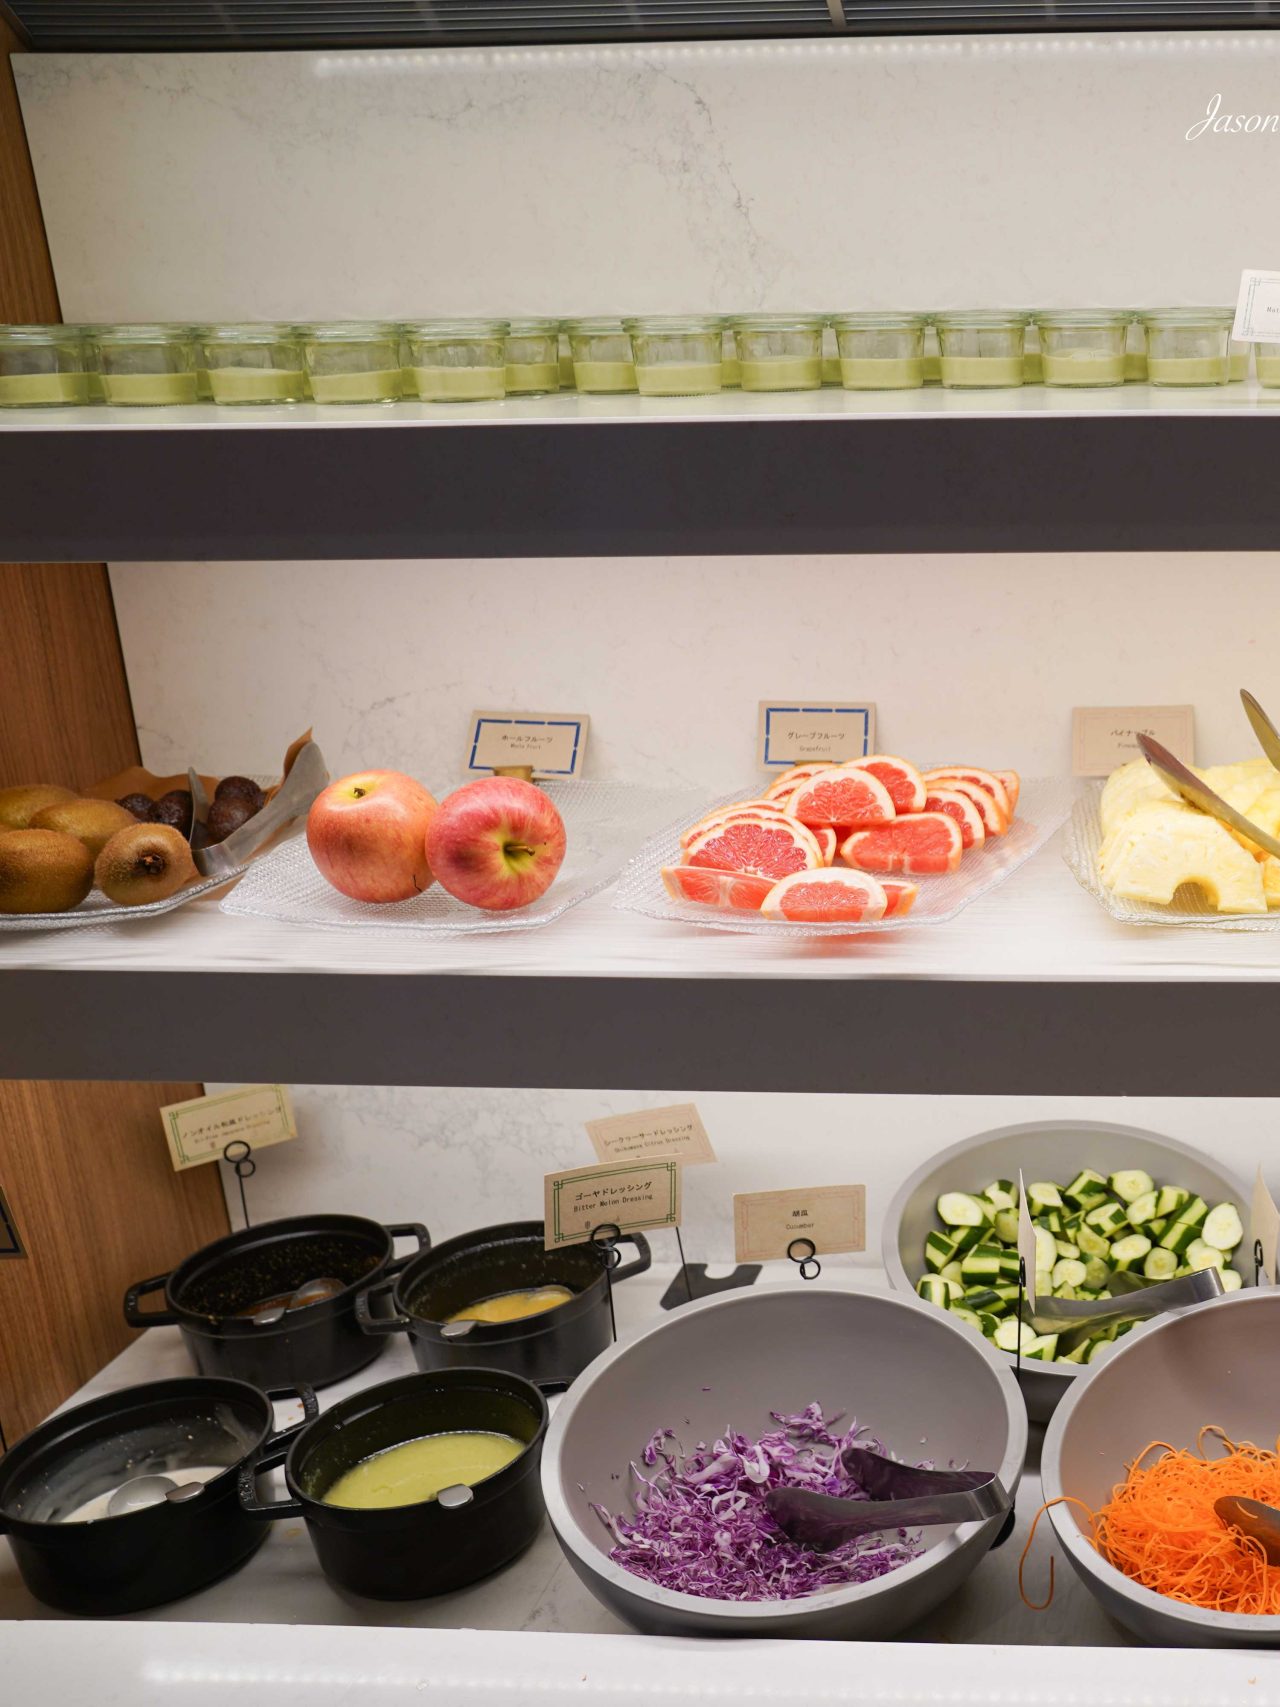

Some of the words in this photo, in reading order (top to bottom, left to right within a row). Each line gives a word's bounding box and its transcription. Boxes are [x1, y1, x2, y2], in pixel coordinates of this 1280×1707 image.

[787, 730, 845, 740] グレープフルーツ
[575, 1181, 653, 1201] ゴーヤドレッシング
[573, 1202, 597, 1213] Bitter
[599, 1199, 620, 1208] Melon
[622, 1194, 654, 1204] Dressing
